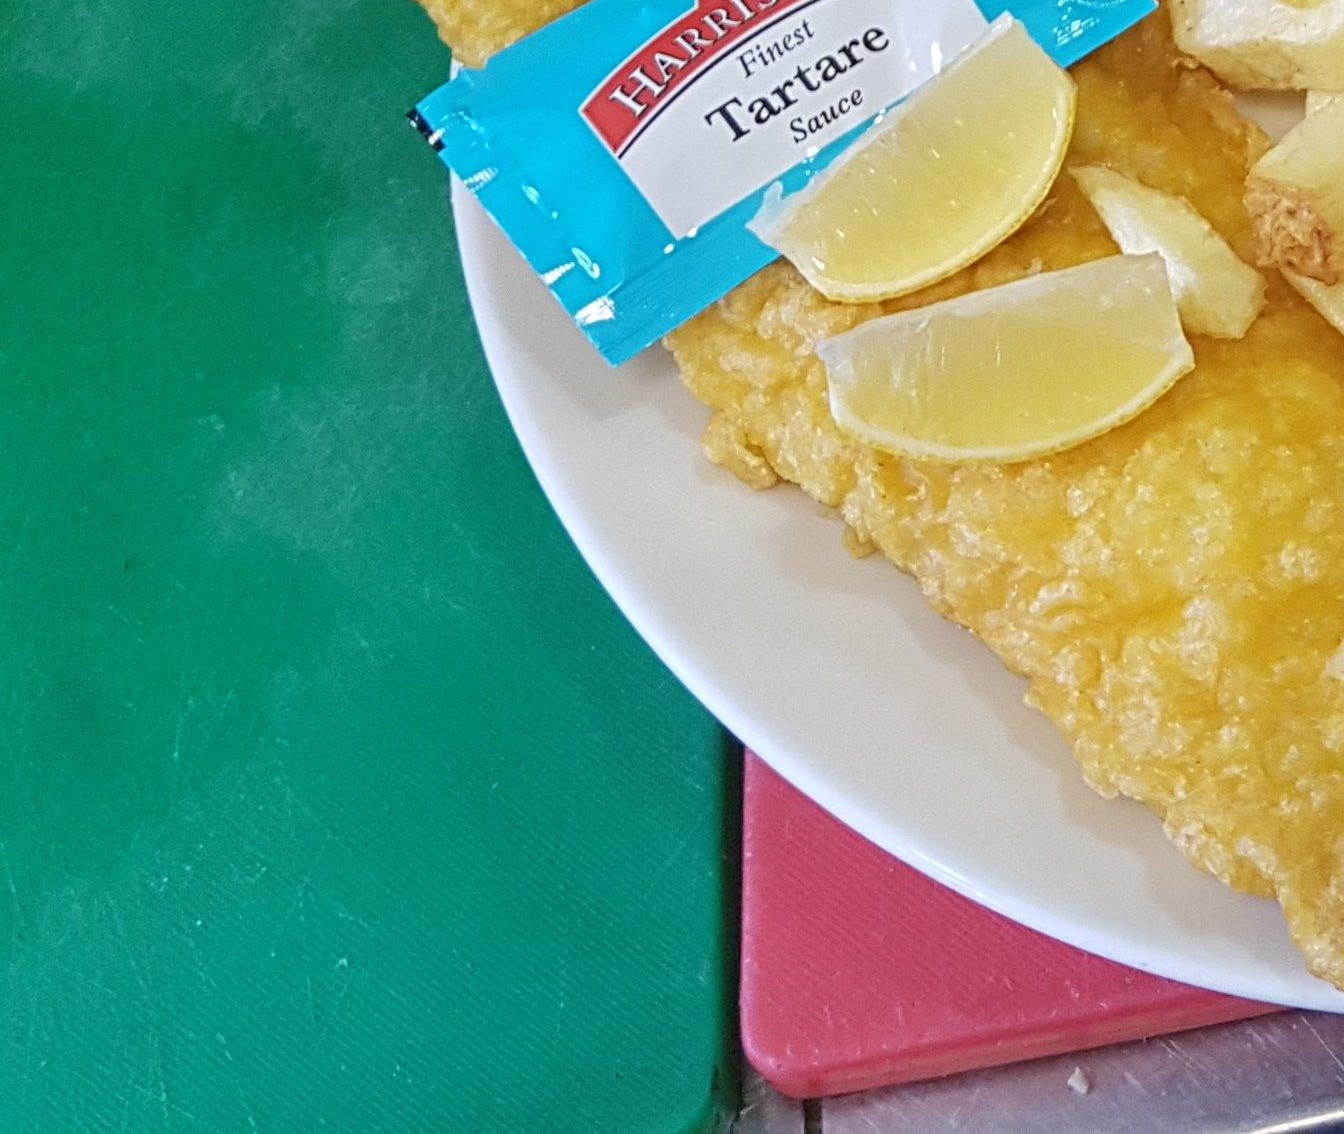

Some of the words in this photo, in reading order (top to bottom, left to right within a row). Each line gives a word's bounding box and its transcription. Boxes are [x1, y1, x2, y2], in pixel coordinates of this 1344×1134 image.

[737, 18, 816, 78] Finest
[703, 26, 890, 143] Tartare
[787, 87, 865, 145] Sauce
